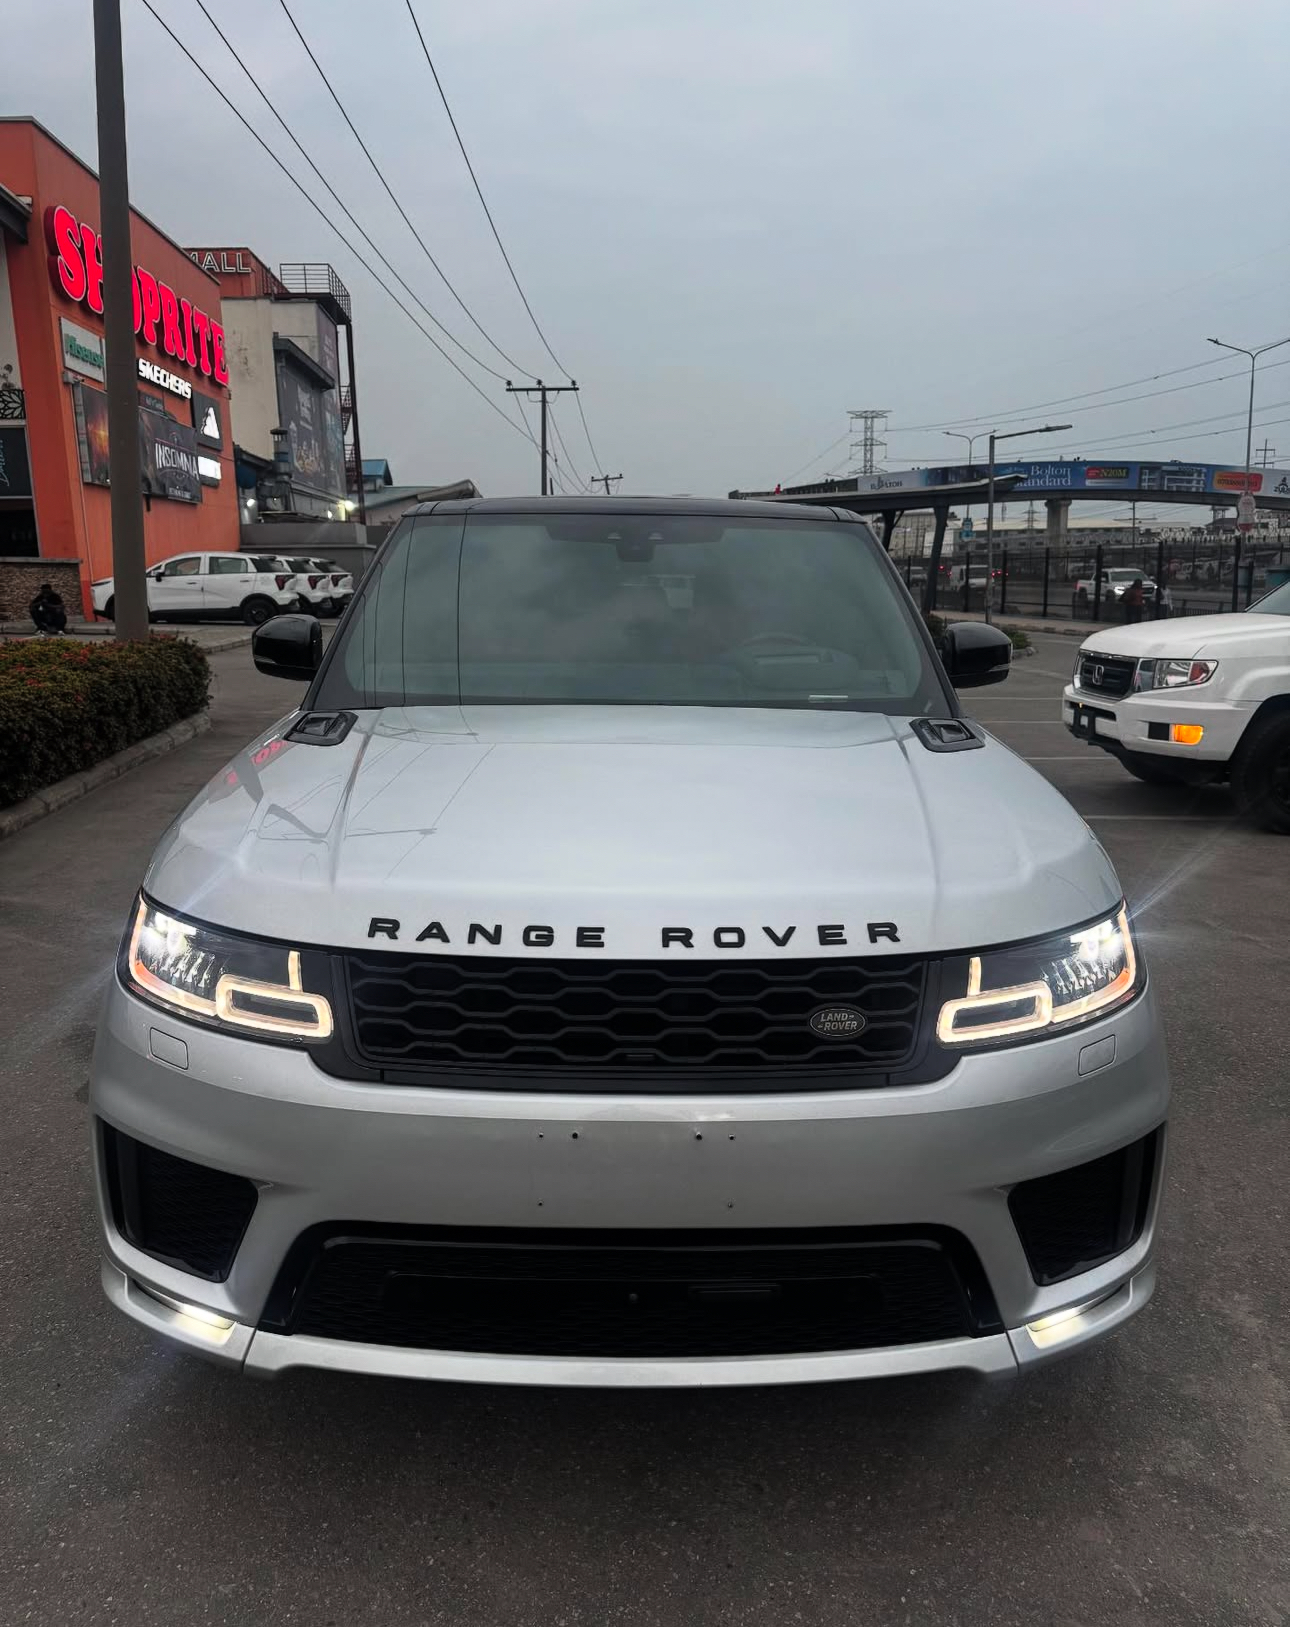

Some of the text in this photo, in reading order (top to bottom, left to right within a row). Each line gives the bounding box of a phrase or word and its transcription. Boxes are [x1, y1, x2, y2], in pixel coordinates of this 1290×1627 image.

[138, 358, 192, 399] SKECHERS
[1031, 464, 1073, 476] Bolton
[367, 917, 901, 948] RANGE ROVER
[820, 1013, 848, 1022] LAND
[824, 1021, 857, 1031] ROVER
